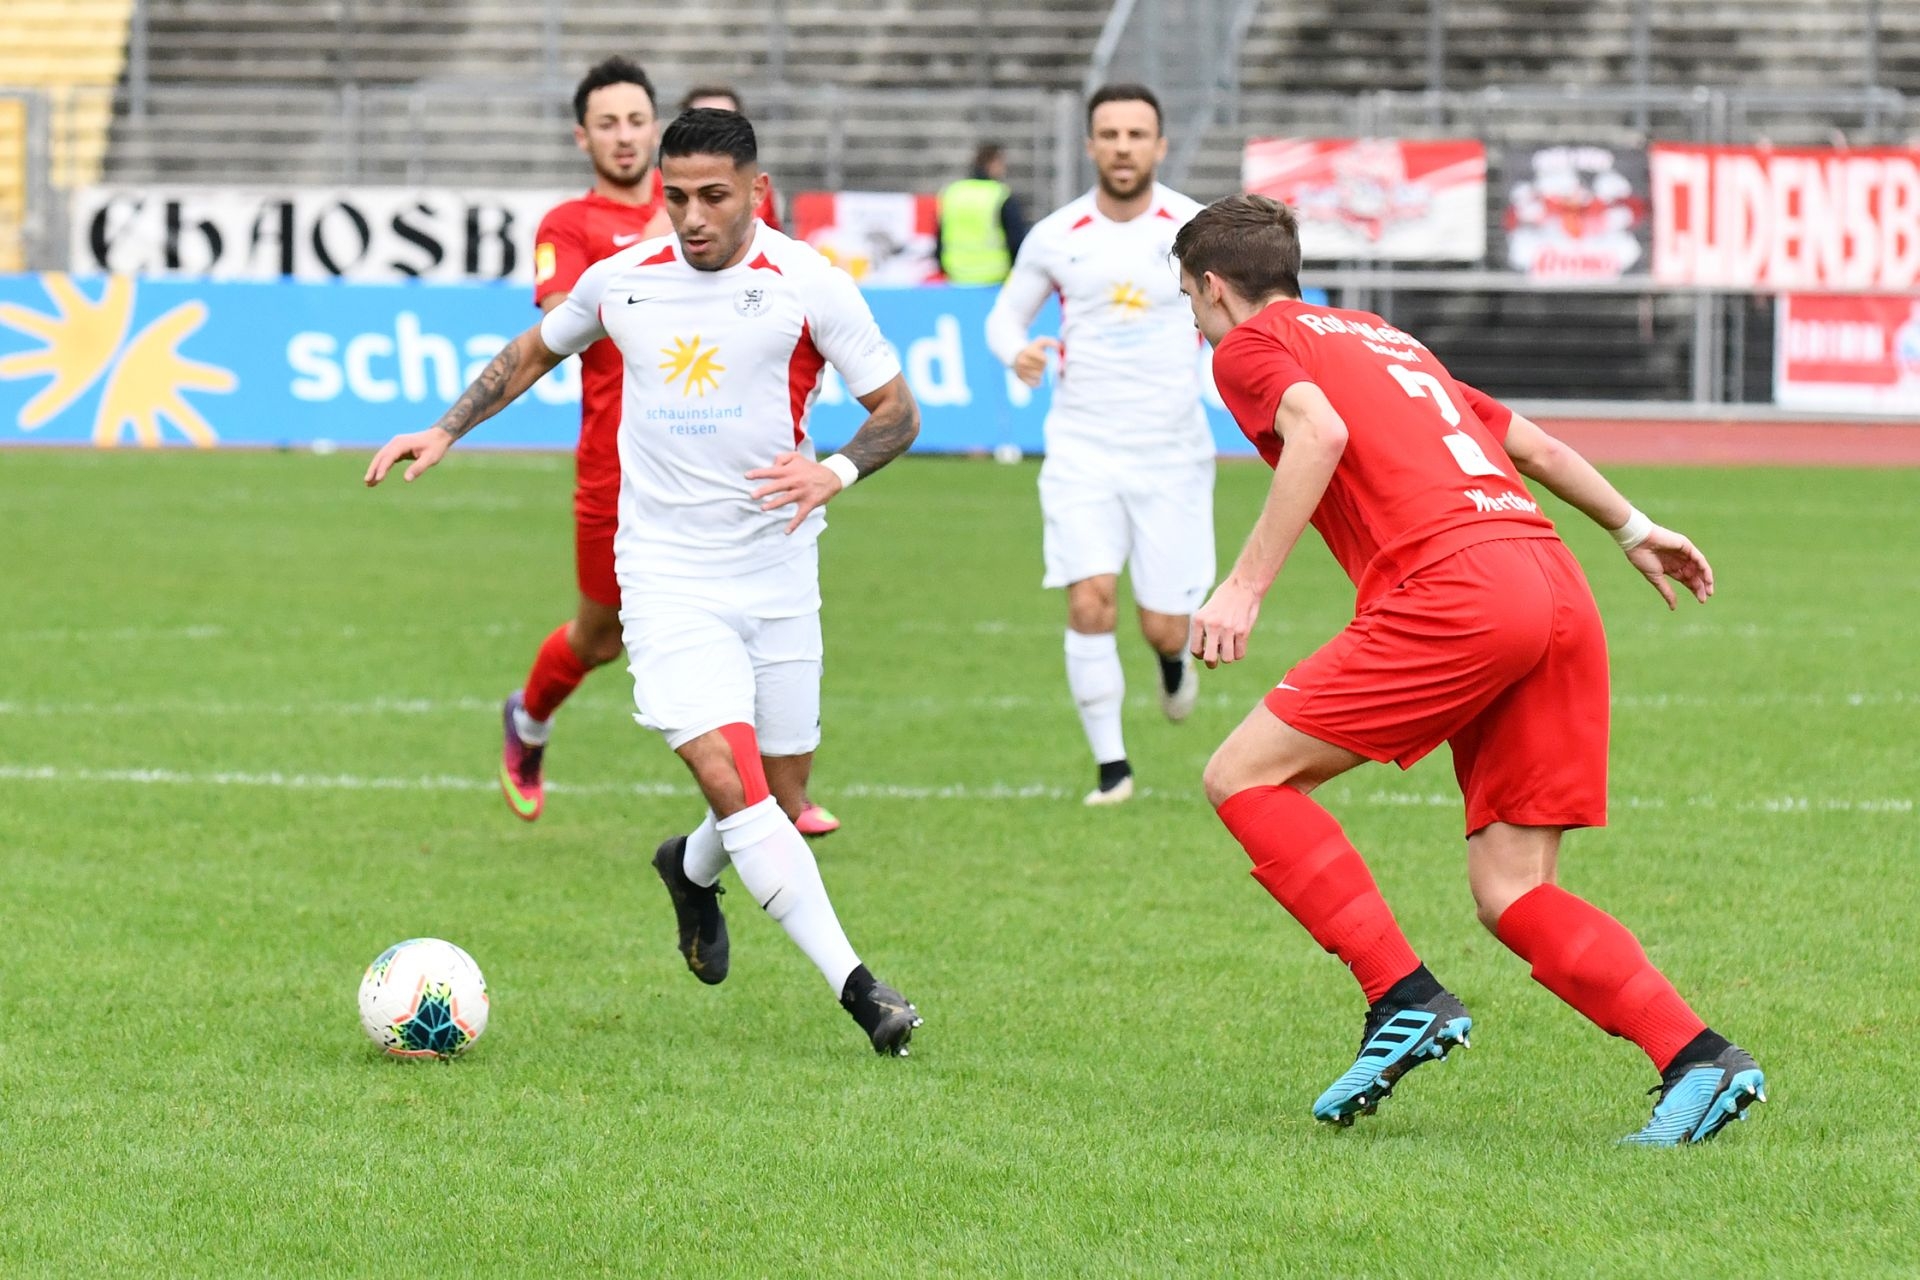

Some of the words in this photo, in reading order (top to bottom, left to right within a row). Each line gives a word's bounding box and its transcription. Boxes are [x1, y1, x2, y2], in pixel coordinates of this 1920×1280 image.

[646, 405, 743, 420] schauinsland
[1386, 364, 1507, 477] 2
[669, 422, 717, 435] reisen
